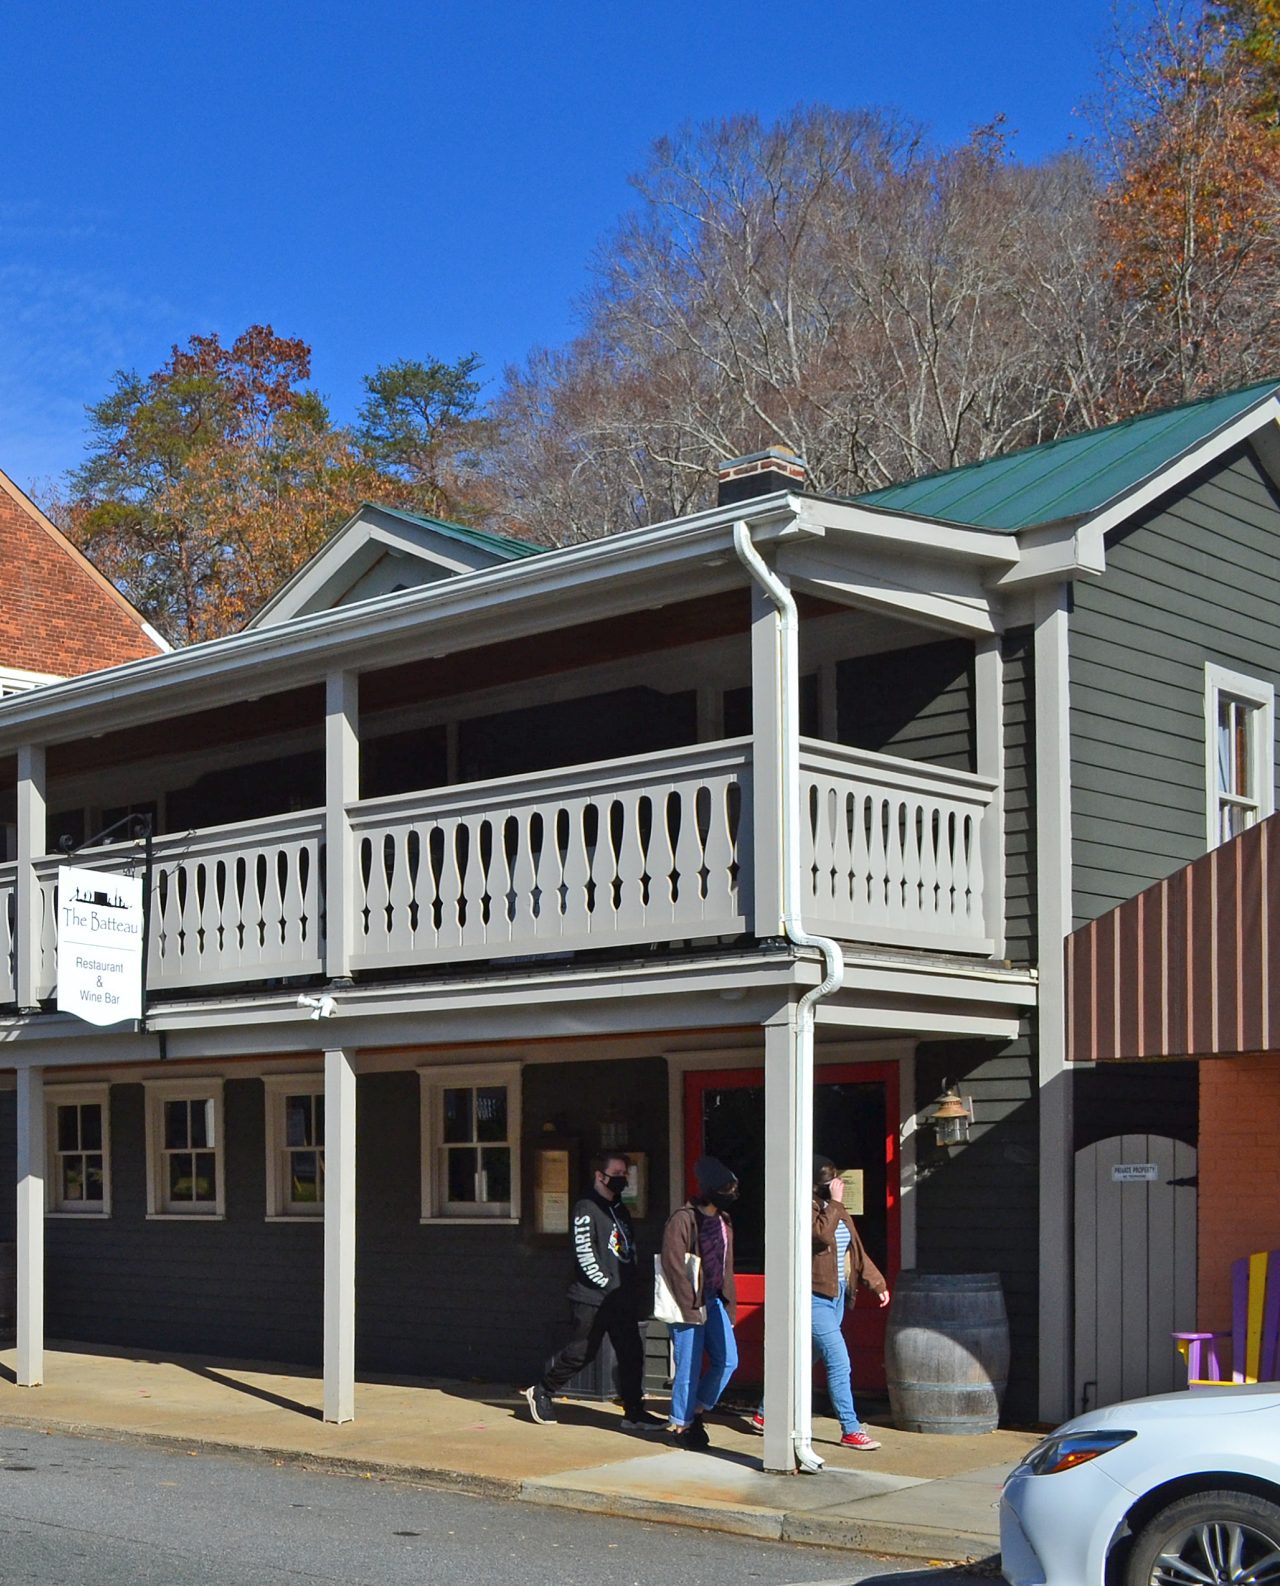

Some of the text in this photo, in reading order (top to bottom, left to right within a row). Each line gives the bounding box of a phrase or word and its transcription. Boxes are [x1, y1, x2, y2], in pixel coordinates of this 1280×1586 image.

[63, 907, 138, 934] The Batteau
[76, 956, 124, 973] Restaurant
[96, 975, 103, 988] &
[80, 990, 120, 1005] Wine Bar
[1114, 1166, 1155, 1174] PRIVATE PROPERTY
[574, 1214, 609, 1288] HOGWARTS
